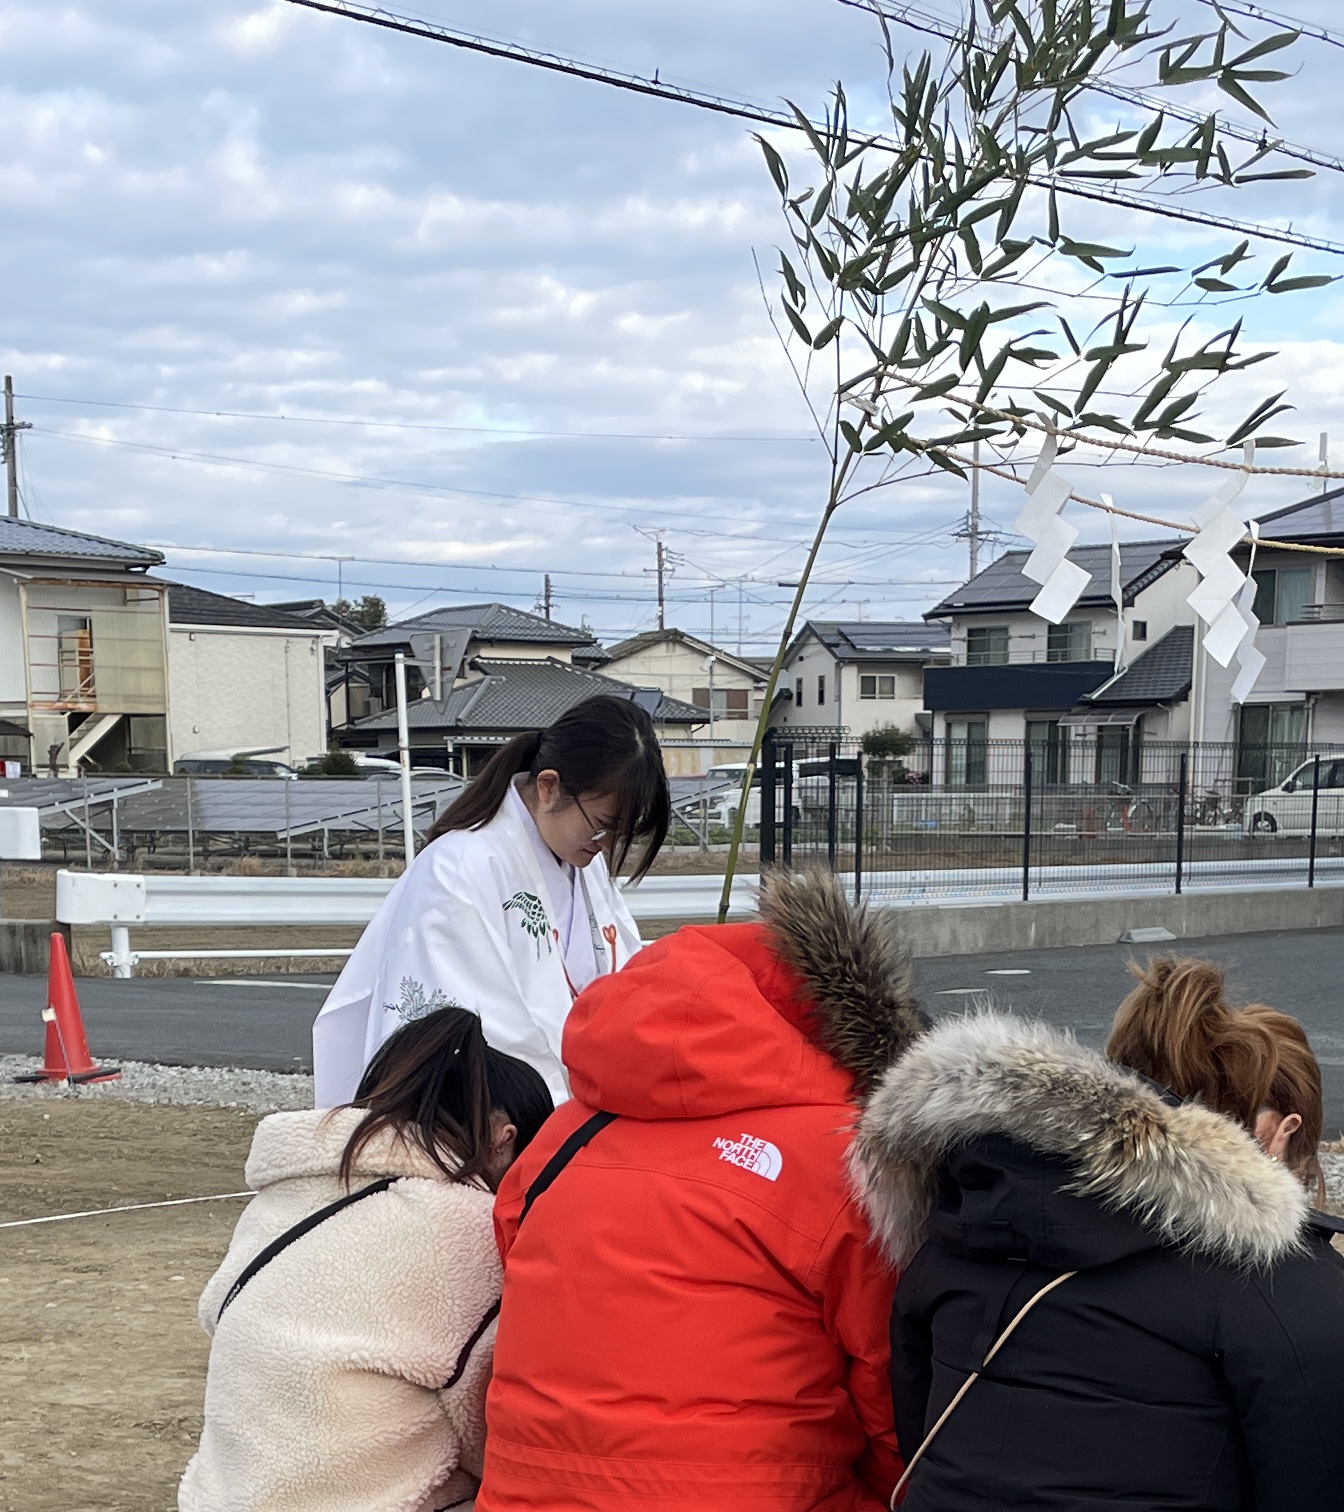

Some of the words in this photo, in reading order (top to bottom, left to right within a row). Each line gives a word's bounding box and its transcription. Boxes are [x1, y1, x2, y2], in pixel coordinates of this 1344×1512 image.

[712, 1137, 762, 1161] NORTH
[740, 1132, 766, 1151] THE
[718, 1149, 755, 1170] FACE
